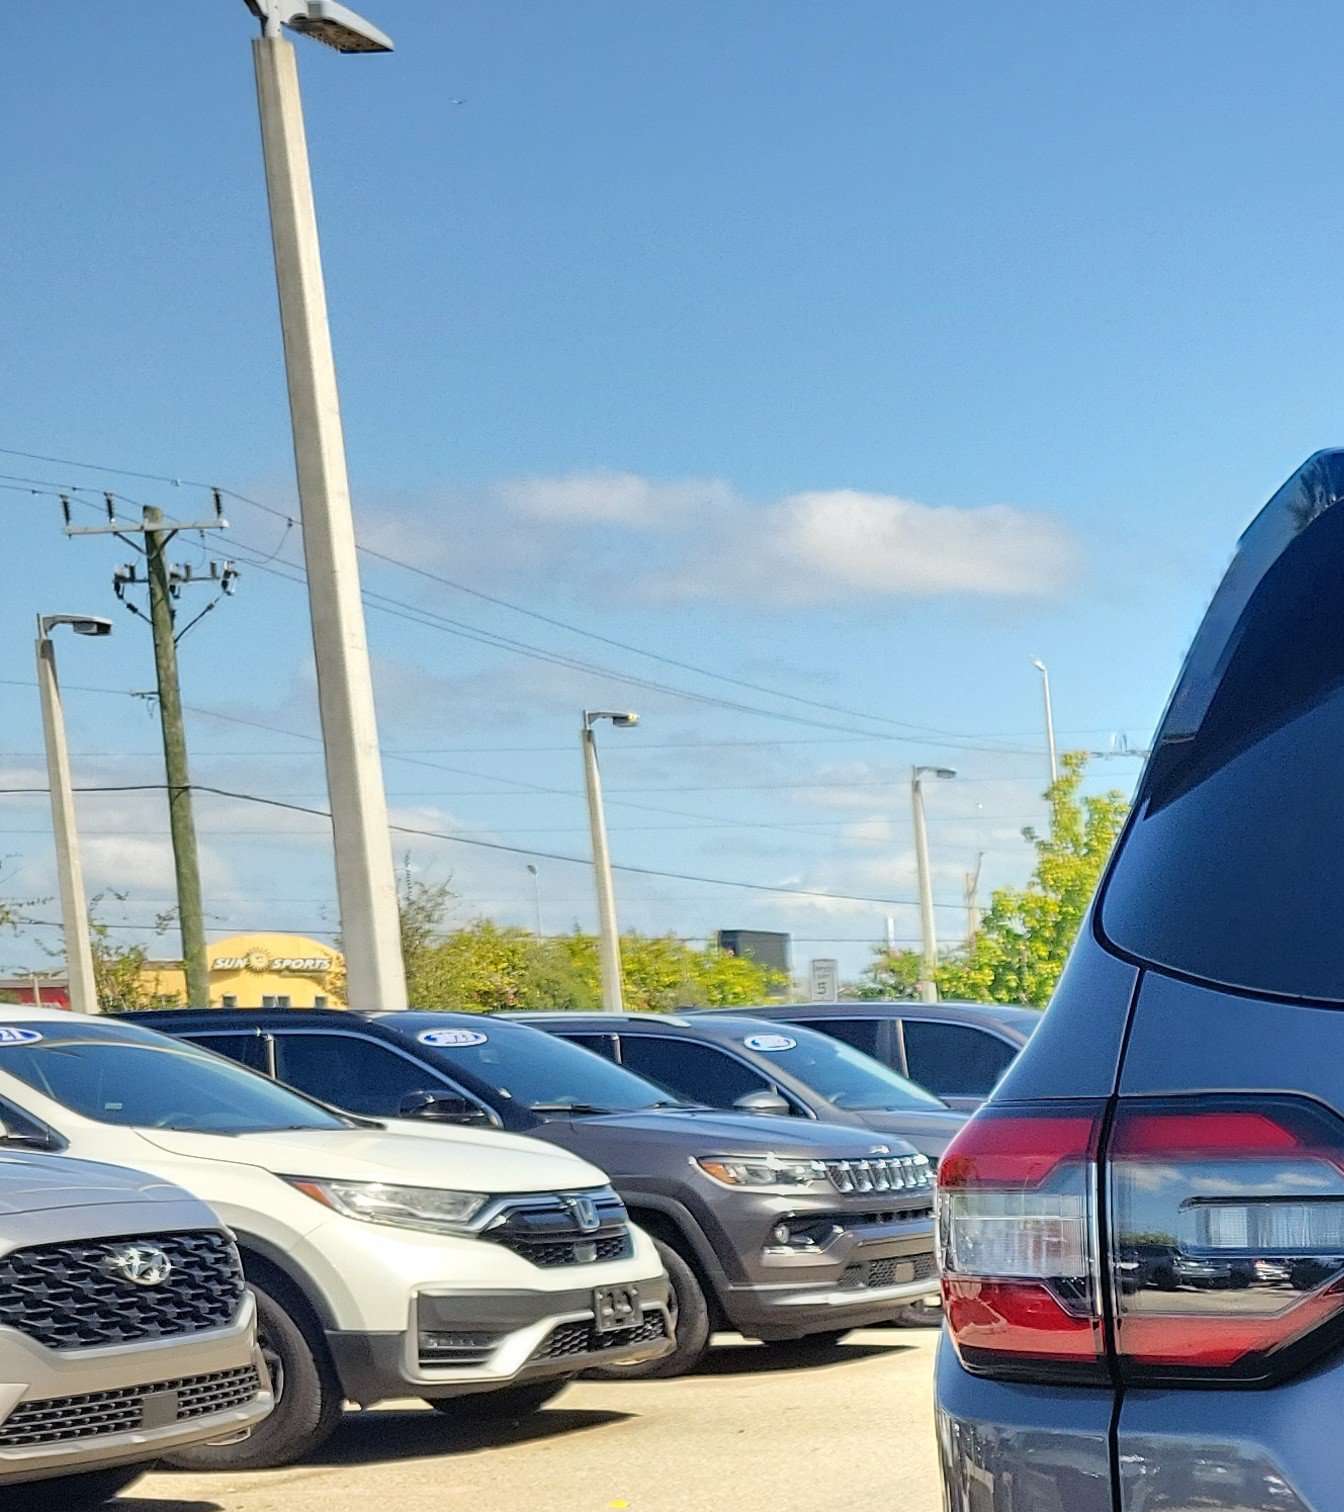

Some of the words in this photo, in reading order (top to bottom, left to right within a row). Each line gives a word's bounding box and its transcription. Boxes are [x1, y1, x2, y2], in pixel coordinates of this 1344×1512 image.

[212, 957, 248, 970] SUN
[270, 957, 331, 971] SPORTS
[817, 982, 827, 995] 5
